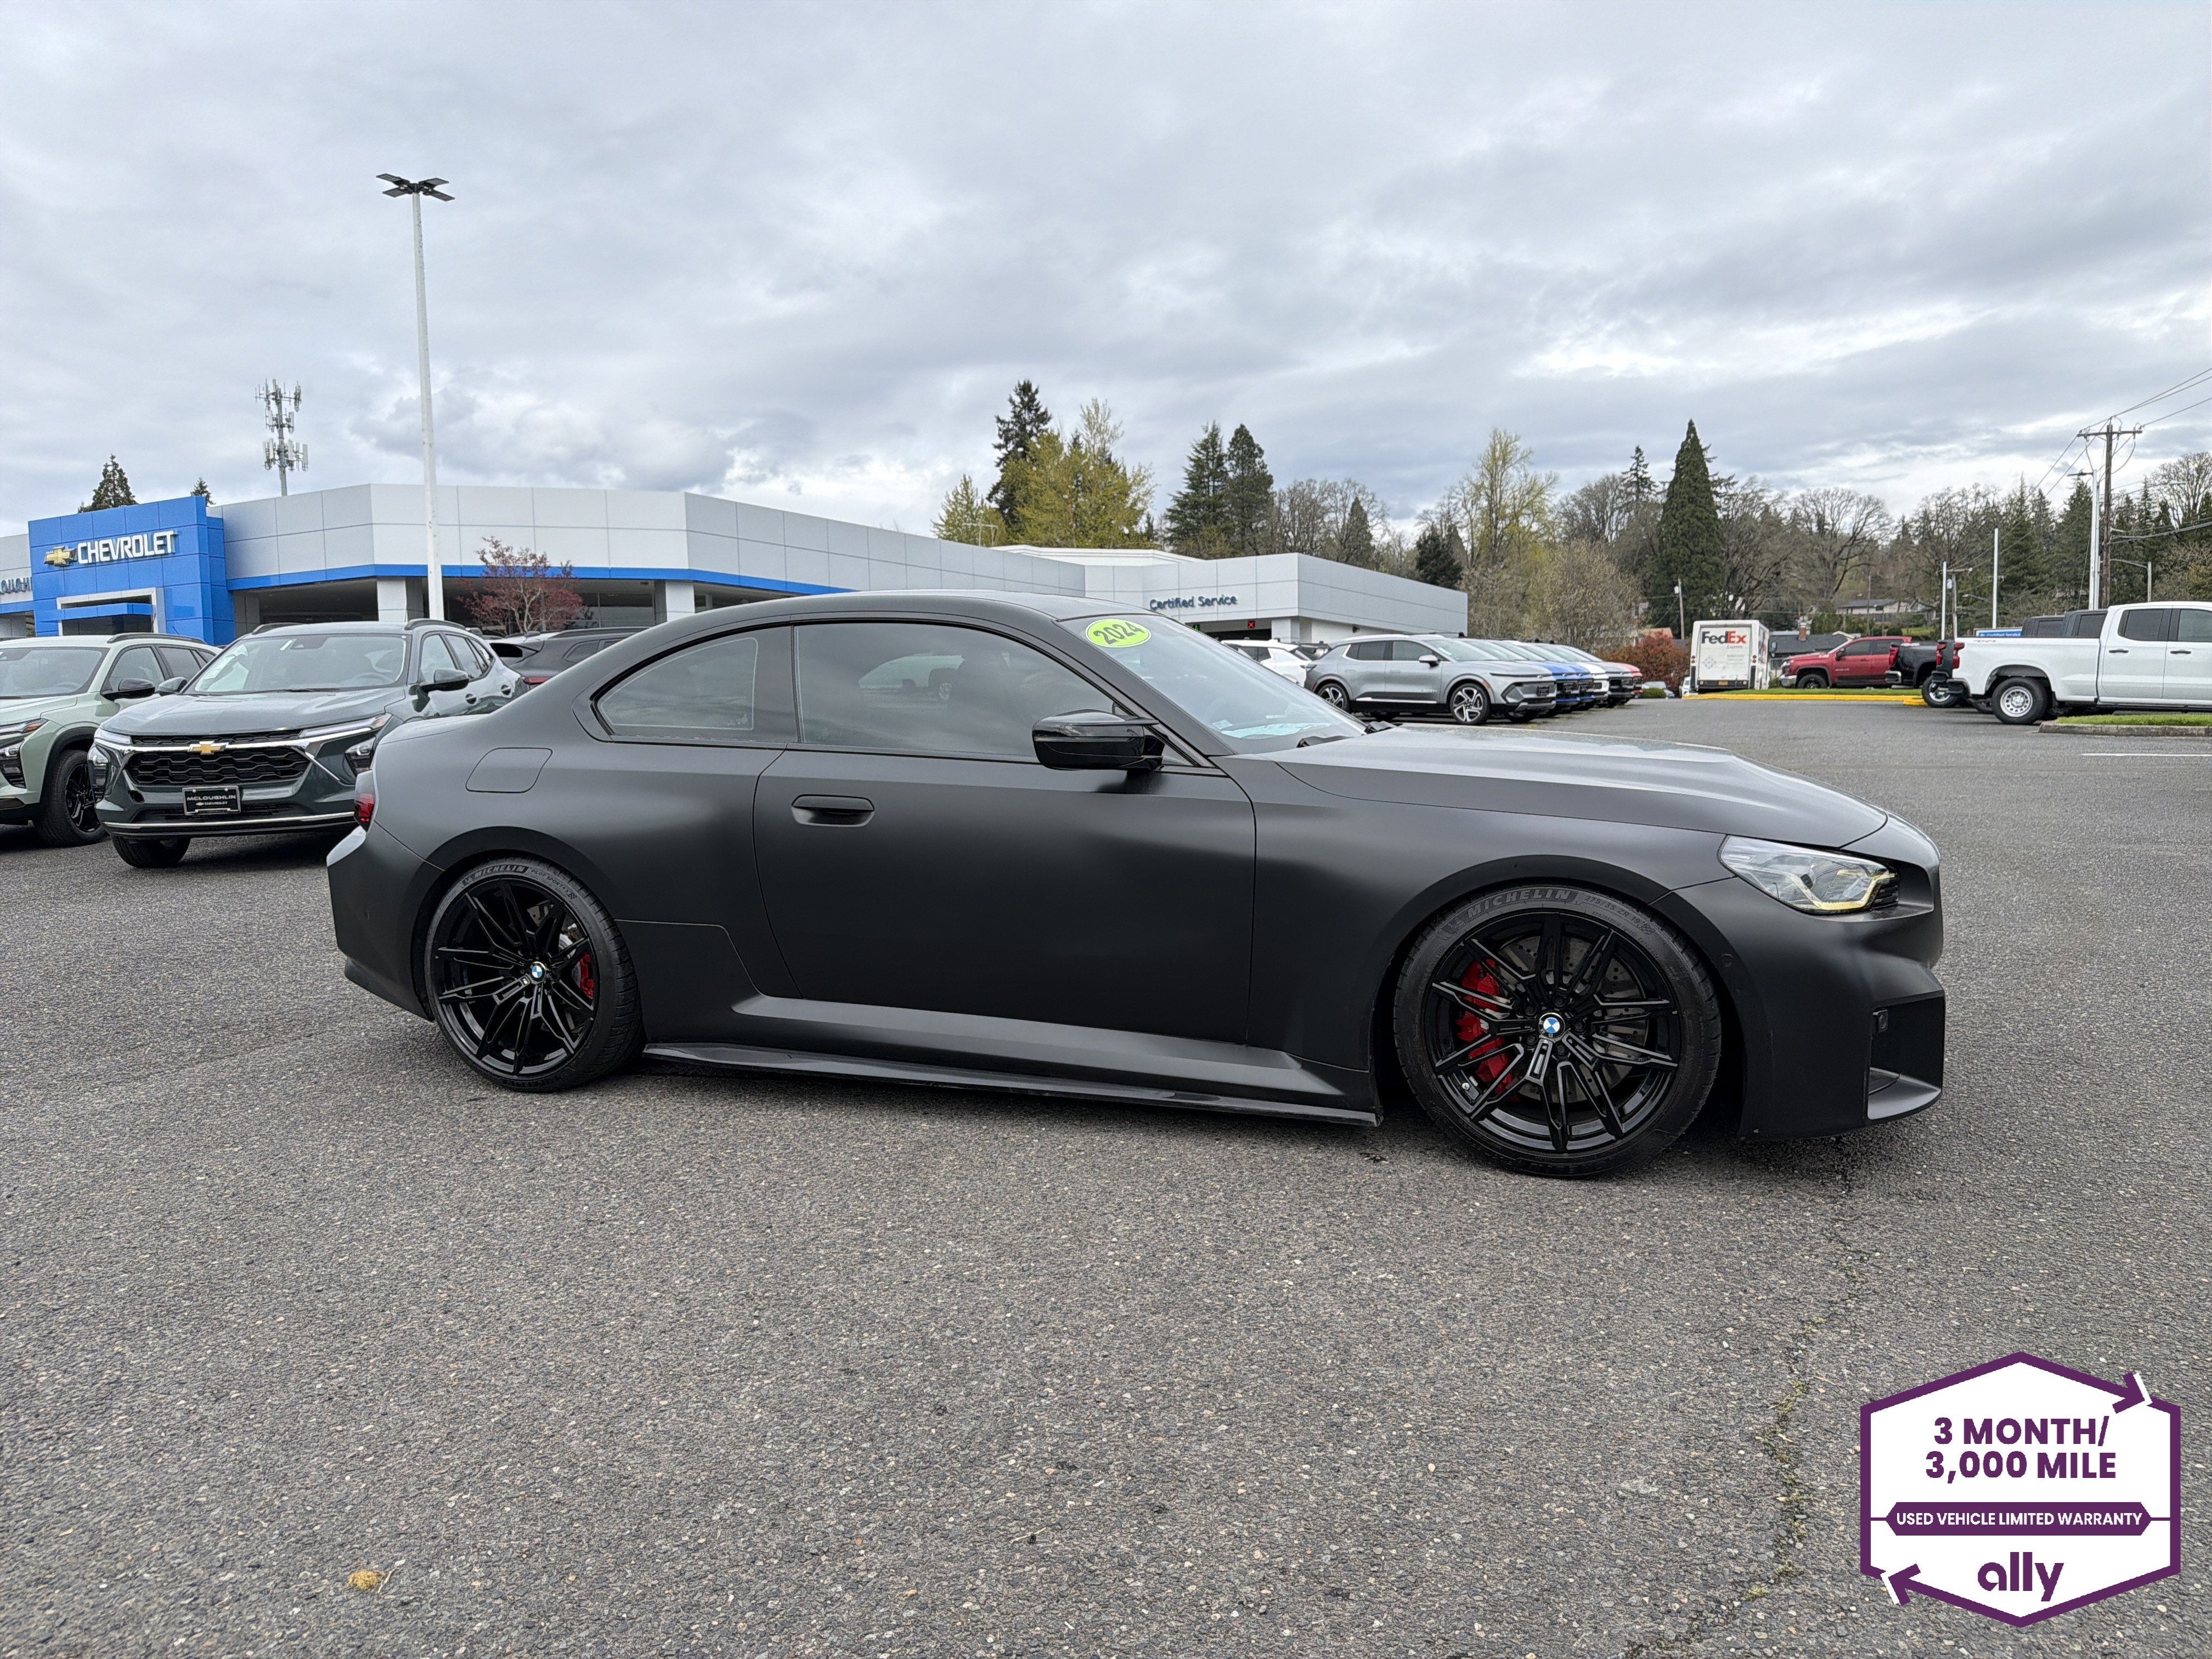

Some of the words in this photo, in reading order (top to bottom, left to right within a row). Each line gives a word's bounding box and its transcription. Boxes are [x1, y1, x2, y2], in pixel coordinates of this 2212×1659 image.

[77, 530, 174, 565] CHEVROLET
[1149, 596, 1194, 611] Certified
[1198, 594, 1238, 607] Service
[1093, 622, 1146, 645] 2024
[1701, 631, 1747, 644] FedEx
[475, 865, 525, 878] MICHELIN
[531, 869, 546, 877] PILOT
[547, 876, 563, 889] SPORT
[1468, 889, 1571, 919] MICHELIN
[1585, 895, 1616, 911] 275/35
[1617, 909, 1630, 918] ZR
[1631, 916, 1641, 924] 19
